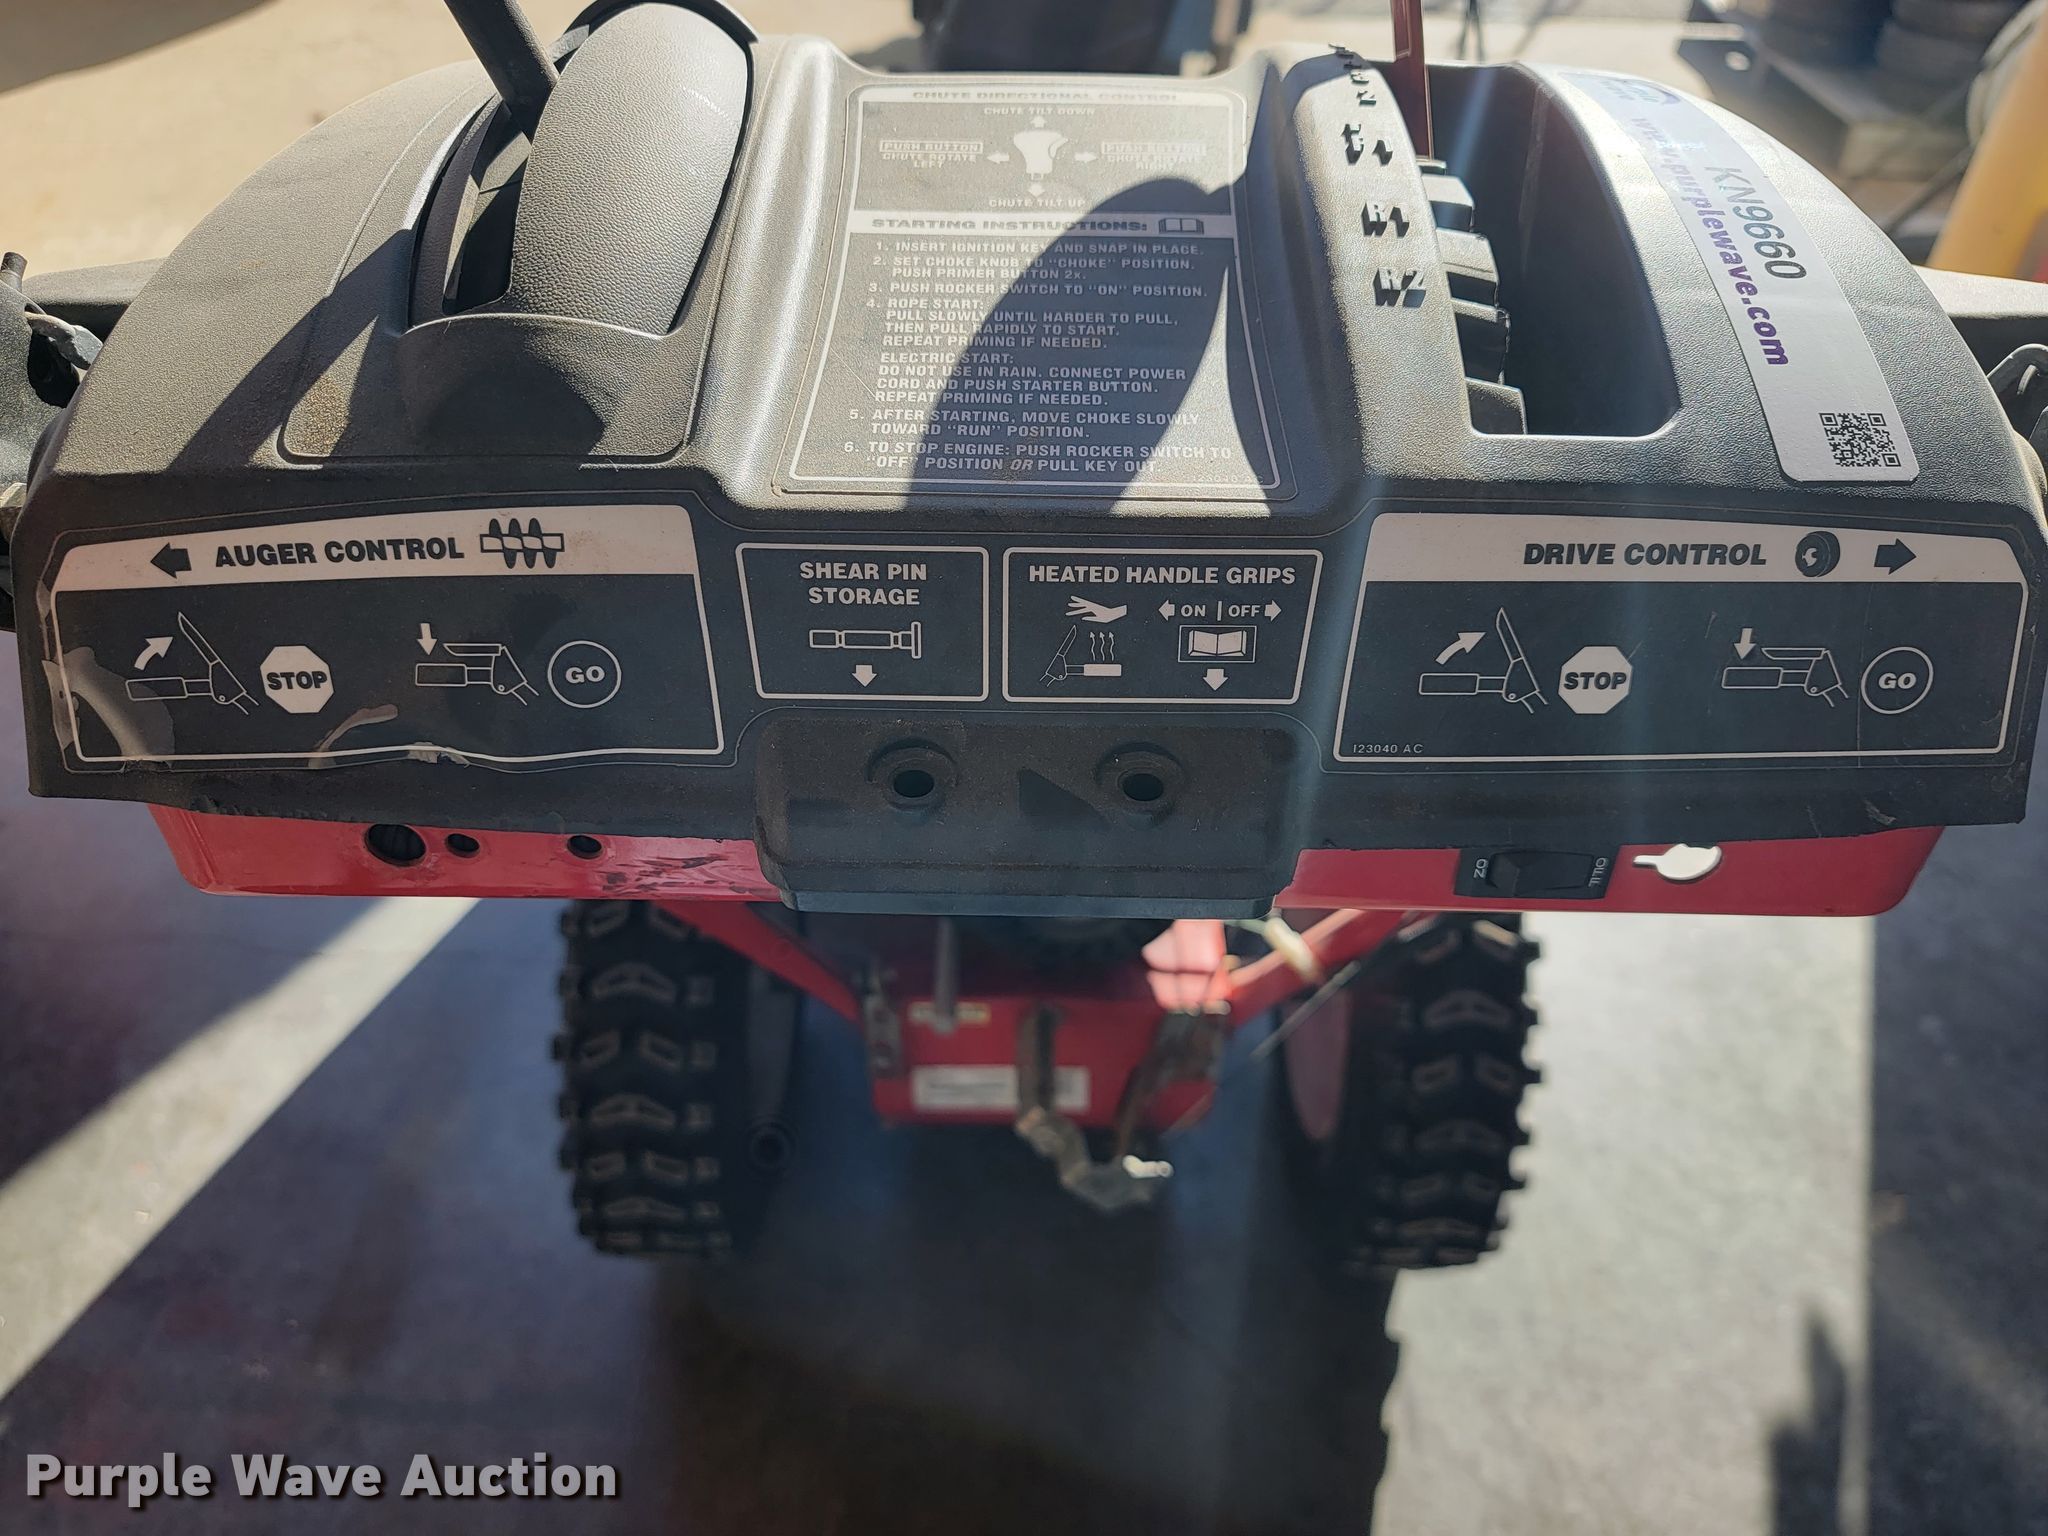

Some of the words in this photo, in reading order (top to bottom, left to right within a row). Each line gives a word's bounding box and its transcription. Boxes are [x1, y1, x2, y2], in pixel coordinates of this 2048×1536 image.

[913, 91, 970, 100] CHUTE
[975, 92, 1093, 101] DIRECTIONAL
[1097, 92, 1177, 102] CONTROL
[984, 107, 1024, 115] CHUTE
[1028, 107, 1056, 115] TILT
[1058, 108, 1095, 116] DOWN
[883, 143, 921, 152] PUSH
[925, 143, 979, 152] BUTTON
[883, 153, 926, 162] CHUTE
[929, 154, 976, 163] ROTATE
[913, 160, 944, 168] LEFT
[989, 199, 1029, 207] CHUTE
[1033, 199, 1065, 207] TILT
[872, 219, 976, 229] STARTING
[983, 220, 1147, 231] INSTRUCTIONS:
[1705, 166, 1807, 280] KN9660
[875, 243, 889, 251] 1.
[896, 243, 947, 252] INSERT
[952, 243, 1017, 253] IGNITION
[1020, 244, 1047, 253] KEY
[1055, 244, 1083, 253] AND
[1089, 244, 1127, 254] SNAP
[1132, 245, 1147, 254] IN
[1152, 245, 1204, 255] PLACE.
[873, 257, 886, 266] 2.
[893, 257, 922, 267] SET
[926, 257, 975, 267] CHOKE
[980, 257, 1019, 267] KNOB
[1026, 258, 1044, 268] TO
[1121, 259, 1195, 269] POSITION.
[892, 269, 934, 278] PUSH
[938, 269, 995, 279] PRIMER
[1002, 269, 1059, 279] BUTTON
[1065, 270, 1086, 280] 2x.
[869, 283, 882, 293] 3.
[890, 283, 930, 293] PUSH
[934, 284, 995, 294] ROCKER
[1000, 284, 1059, 294] SWITCH
[1064, 284, 1083, 294] TO
[1132, 285, 1207, 296] POSITION.
[866, 299, 880, 308] 4.
[888, 299, 928, 309] ROPE
[933, 299, 984, 310] START:
[886, 310, 925, 321] PULL
[929, 311, 988, 322] SLOWLY
[994, 312, 1039, 322] UNTIL
[1043, 312, 1104, 323] HARDER
[1110, 313, 1131, 323] TO
[1136, 313, 1178, 326] PULL,
[885, 323, 926, 333] THEN
[930, 323, 967, 334] PULL
[975, 324, 1037, 335] RAPIDLY
[1041, 325, 1062, 335] TO
[1067, 325, 1120, 336] START.
[883, 335, 942, 346] REPEAT
[947, 336, 1017, 347] PRIMING
[1021, 336, 1036, 347] IF
[1041, 337, 1107, 348] NEEDED.
[880, 353, 956, 364] ELECTRIC
[961, 353, 1014, 364] START:
[878, 366, 899, 377] DO
[903, 366, 937, 377] NOT
[942, 366, 974, 377] USE
[978, 367, 994, 378] IN
[999, 367, 1043, 379] RAIN.
[1049, 367, 1123, 379] CONNECT
[1129, 368, 1185, 380] POWER
[876, 378, 921, 389] CORD
[926, 379, 959, 390] AND
[964, 379, 1007, 390] PUSH
[1012, 380, 1084, 391] STARTER
[1089, 380, 1158, 392] BUTTON.
[875, 391, 938, 403] REPEAT
[942, 392, 1013, 403] PRIMING
[1019, 392, 1034, 404] IF
[1039, 393, 1107, 405] NEEDED.
[849, 409, 864, 419] 5.
[872, 409, 924, 421] AFTER
[930, 410, 1016, 424] STARTING,
[1022, 411, 1069, 423] MOVE
[1076, 412, 1131, 424] CHOKE
[1136, 413, 1199, 425] SLOWLY
[870, 422, 941, 435] TOWARD
[1007, 425, 1090, 437] POSITION.
[844, 442, 859, 452] 6.
[869, 442, 889, 453] TO
[894, 442, 939, 454] STOP
[944, 443, 1009, 455] ENGINE:
[1016, 444, 1060, 456] PUSH
[1066, 445, 1134, 457] ROCKER
[1139, 445, 1203, 458] SWITCH
[1209, 446, 1230, 458] TO
[924, 457, 1003, 470] POSITION
[1009, 458, 1032, 470] OR
[1037, 458, 1079, 471] PULL
[1085, 459, 1117, 472] KEY
[1123, 460, 1160, 472] OUT.
[214, 543, 319, 568] AUGER
[325, 537, 464, 563] CONTROL
[1523, 543, 1615, 565] DRIVE
[1623, 544, 1767, 567] CONTROL
[800, 562, 881, 580] SHEAR
[888, 564, 927, 581] PIN
[1029, 566, 1120, 583] HEATED
[1126, 566, 1219, 584] HANDLE
[1226, 567, 1295, 585] GRIPS
[808, 587, 920, 605] STORAGE
[1181, 604, 1206, 618] ON
[1228, 604, 1261, 618] OFF
[266, 670, 327, 691] STOP
[565, 666, 605, 684] GO
[1563, 671, 1627, 691] STOP
[1877, 672, 1916, 690] GO
[1402, 743, 1423, 754] AC
[1473, 858, 1488, 878] ON
[1589, 858, 1606, 888] OFF
